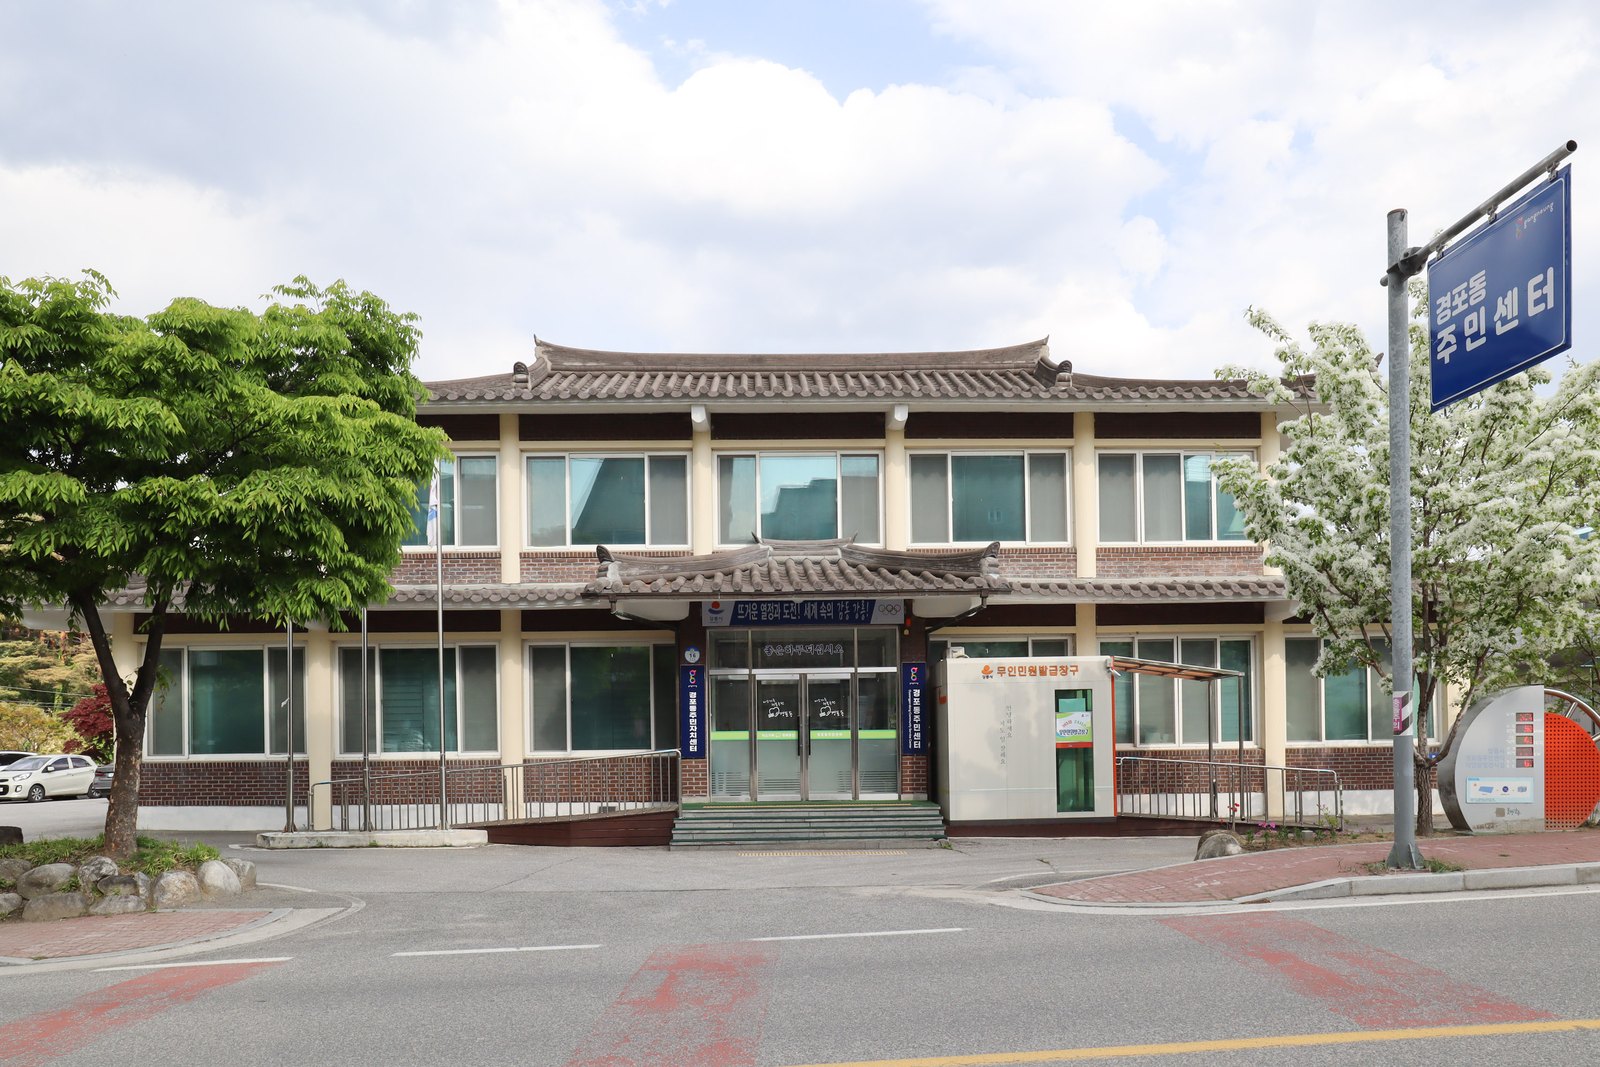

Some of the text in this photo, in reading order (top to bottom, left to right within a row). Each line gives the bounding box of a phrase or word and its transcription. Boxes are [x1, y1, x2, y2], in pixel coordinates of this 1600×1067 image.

[1436, 269, 1487, 326] 경포동
[737, 603, 758, 620] 뜨거운
[760, 603, 781, 620] 열정과
[783, 603, 801, 620] 도전!
[803, 602, 818, 619] 세계
[819, 601, 834, 619] 속의
[996, 664, 1079, 677] 무인민원발급창구
[689, 692, 698, 752] 경포동주민자치센터
